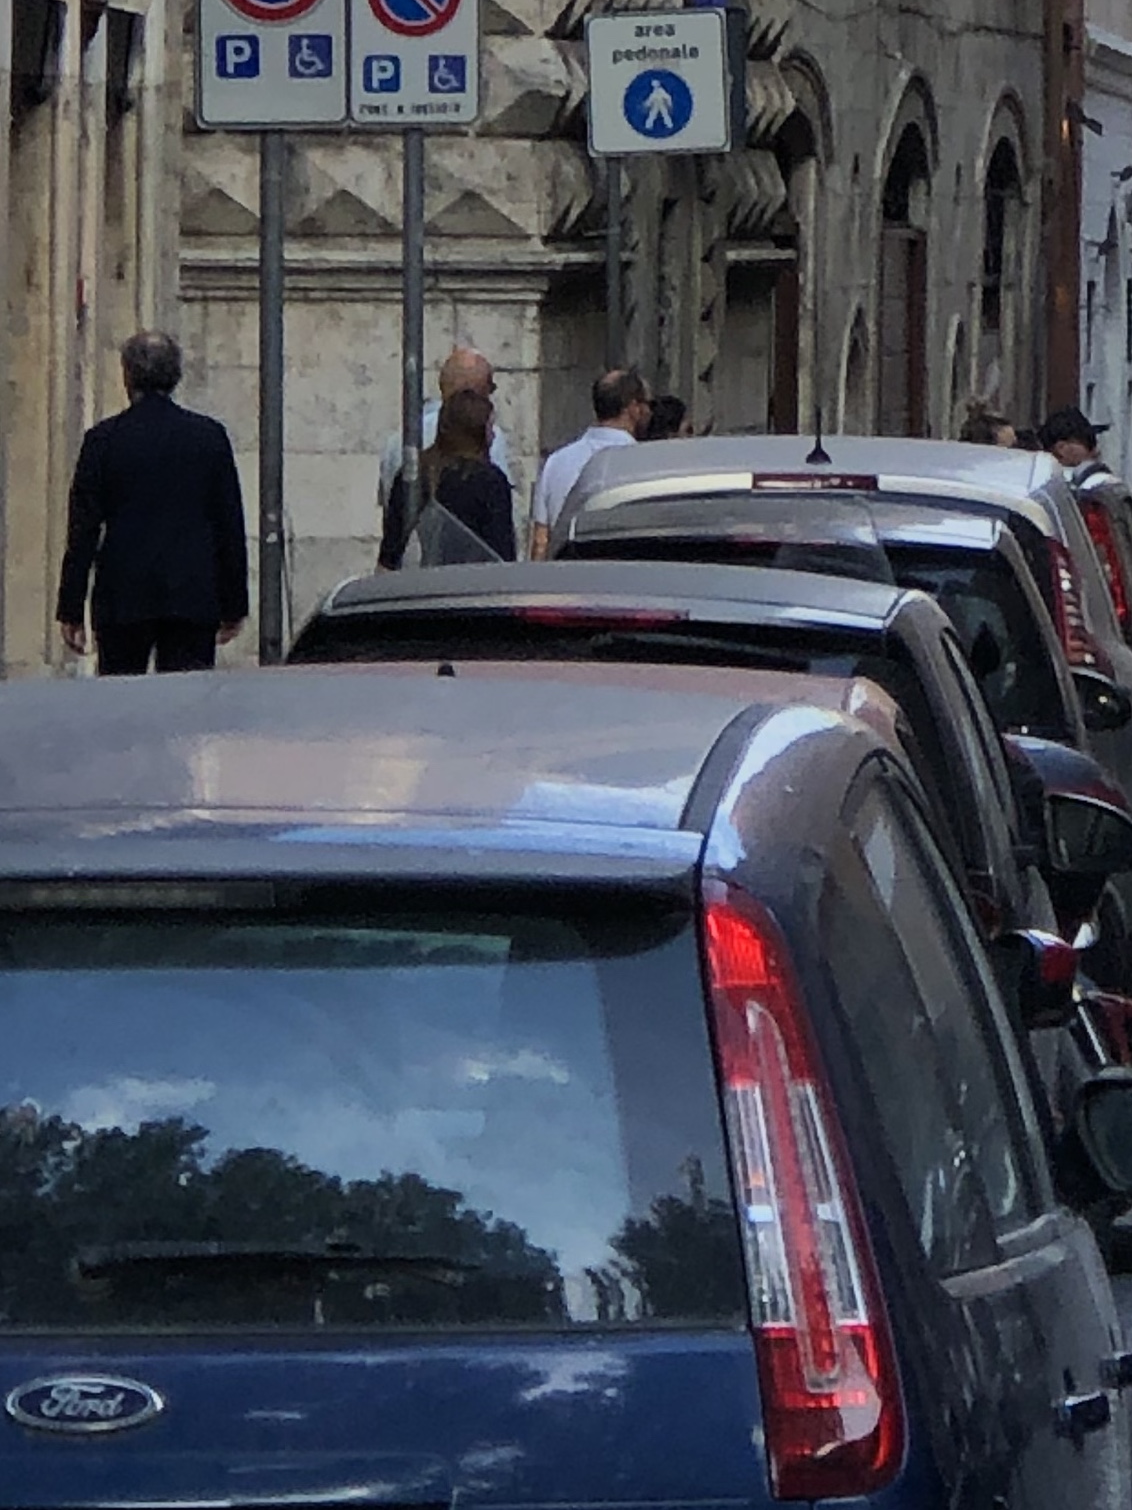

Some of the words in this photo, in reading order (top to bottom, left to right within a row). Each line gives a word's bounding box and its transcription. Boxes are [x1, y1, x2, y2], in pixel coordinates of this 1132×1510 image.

[634, 23, 676, 37] area
[225, 39, 252, 74] P
[612, 43, 699, 65] pedonale
[371, 60, 395, 89] P
[40, 1383, 125, 1418] Ford
